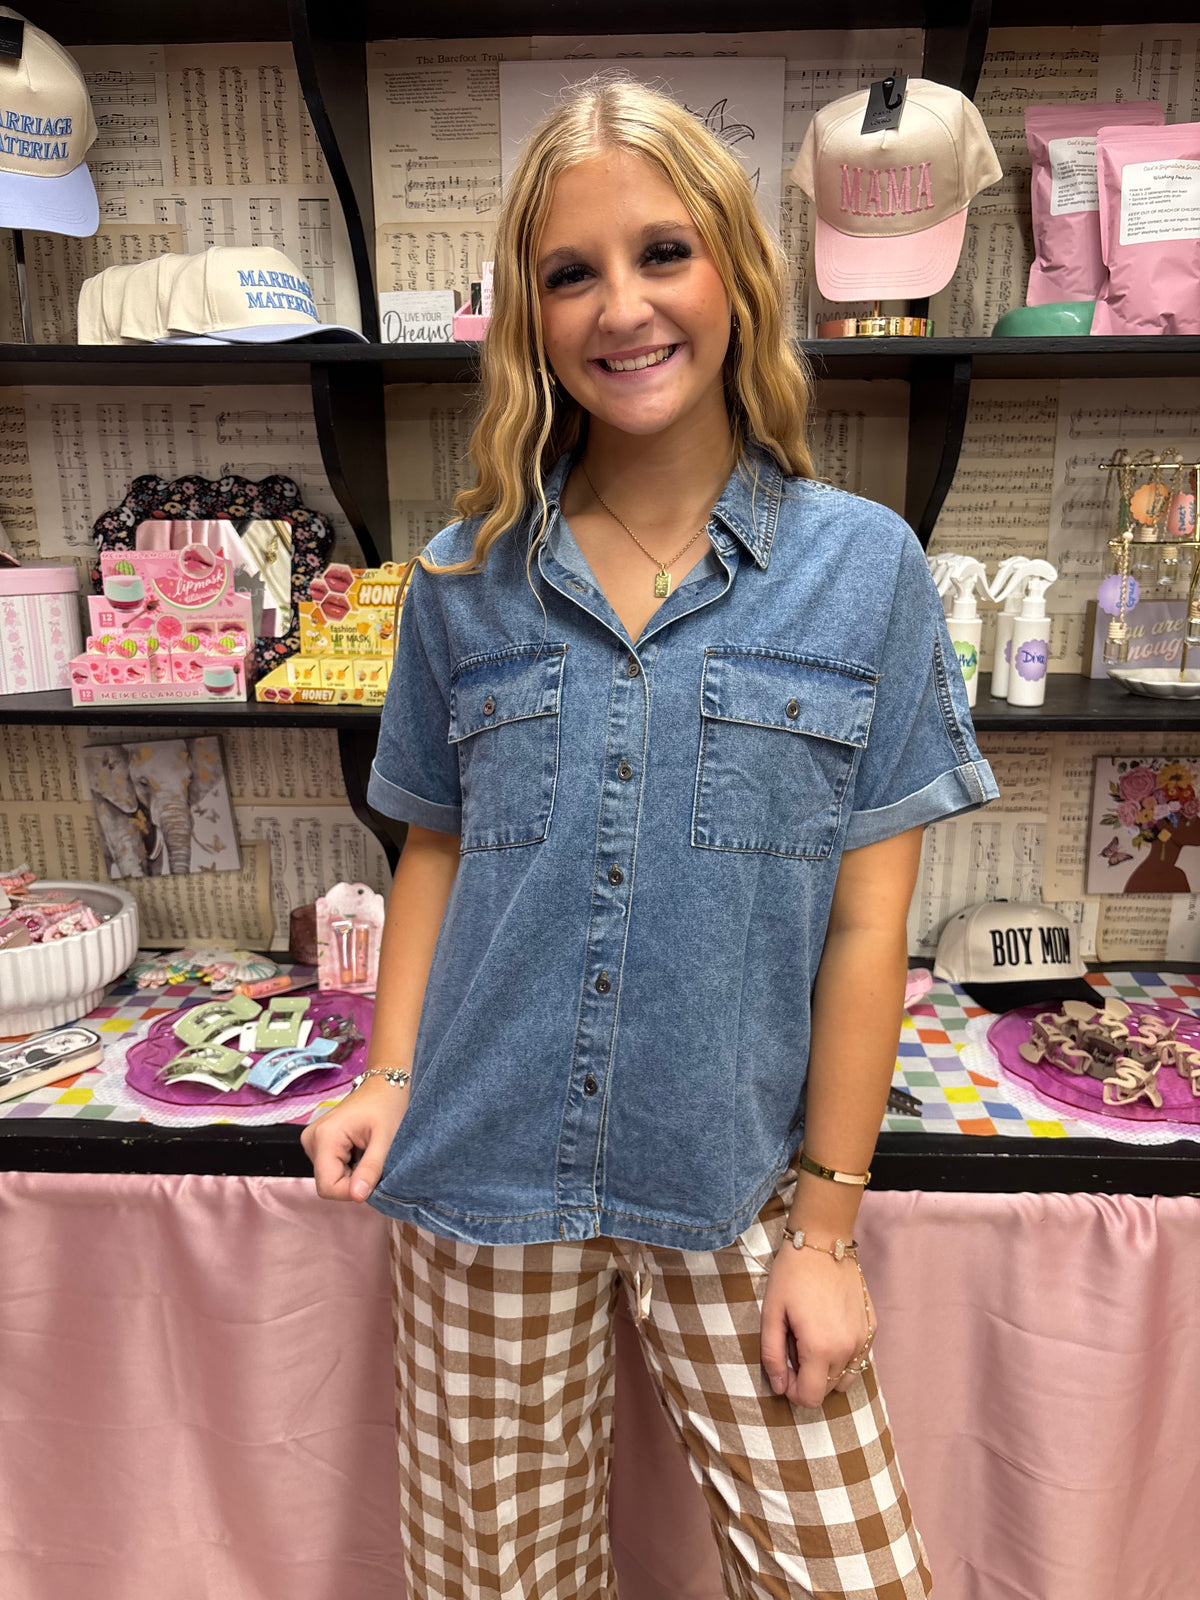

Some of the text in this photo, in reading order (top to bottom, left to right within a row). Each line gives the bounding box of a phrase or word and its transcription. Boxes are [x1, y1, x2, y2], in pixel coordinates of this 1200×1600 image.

[416, 56, 434, 65] The
[438, 54, 477, 64] Barefoot
[840, 161, 935, 217] MAMA
[404, 312, 442, 322] LIVE YOUR
[382, 310, 453, 344] Dreams
[101, 613, 113, 622] 12
[330, 625, 357, 633] fashion
[1126, 618, 1185, 640] ou are
[331, 634, 369, 643] LIP MASK
[1127, 638, 1192, 662] noug
[80, 690, 92, 698] 12
[101, 692, 138, 700] MEIKE
[141, 690, 200, 699] GLAMOUR
[301, 688, 334, 701] HONEY
[989, 926, 1071, 967] BOY MOM
